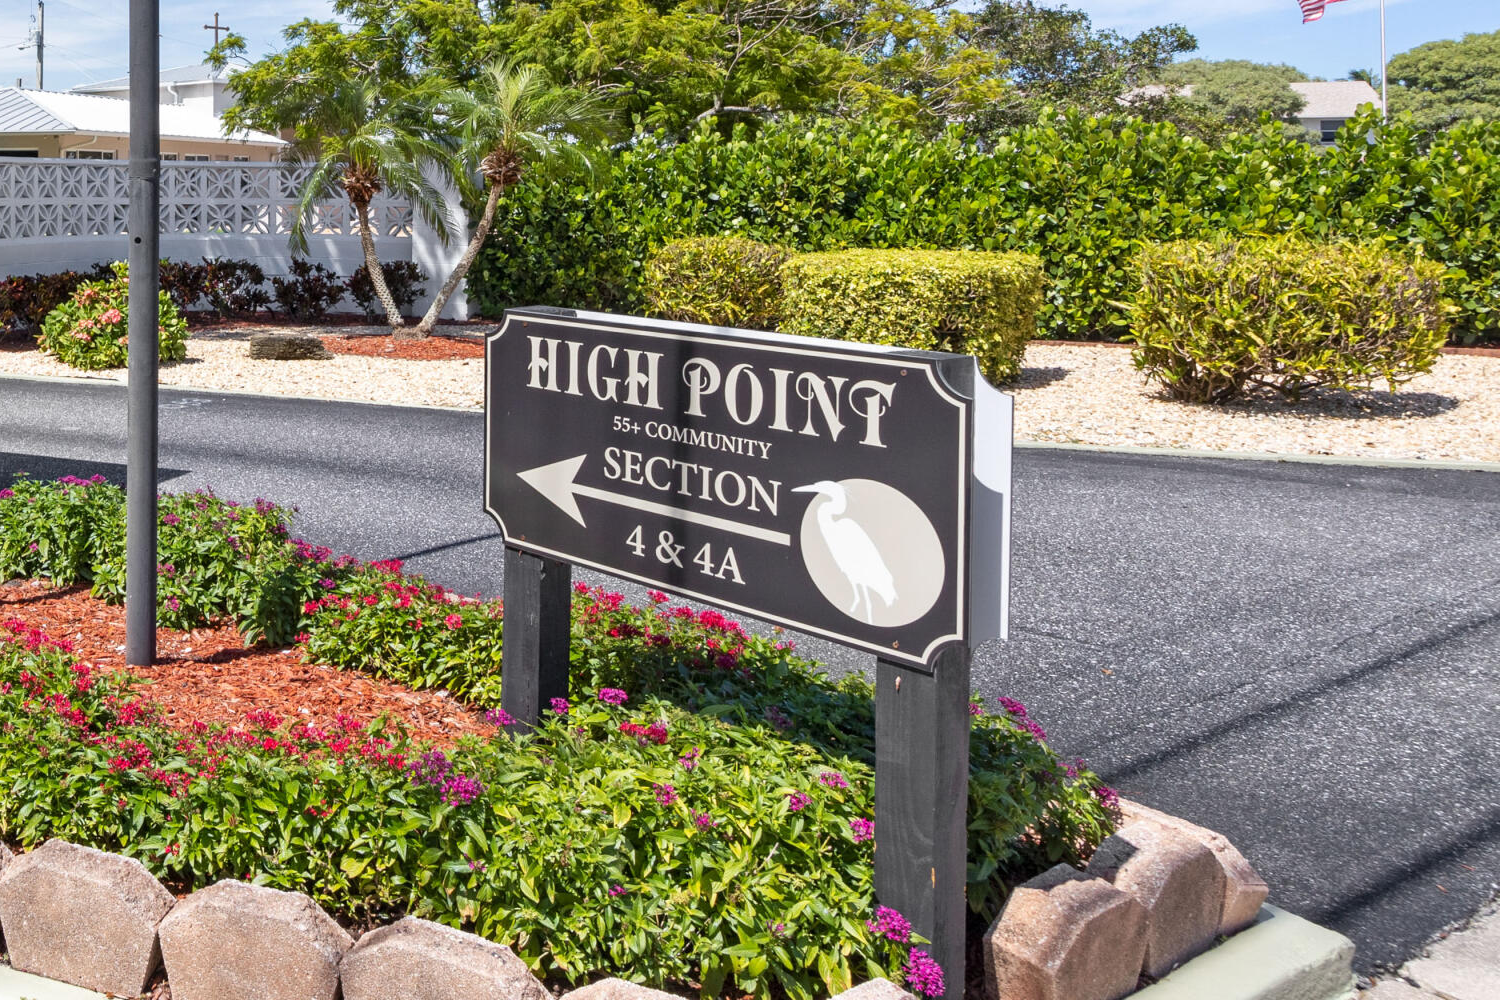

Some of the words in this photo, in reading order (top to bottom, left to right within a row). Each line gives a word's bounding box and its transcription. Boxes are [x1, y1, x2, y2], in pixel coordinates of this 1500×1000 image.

[526, 336, 664, 410] HIGH
[682, 357, 897, 449] POINT
[613, 415, 641, 436] 55+
[645, 420, 773, 460] COMMUNITY
[603, 447, 783, 517] SECTION
[626, 525, 646, 558] 4
[655, 531, 684, 569] &
[693, 542, 746, 585] 4A
